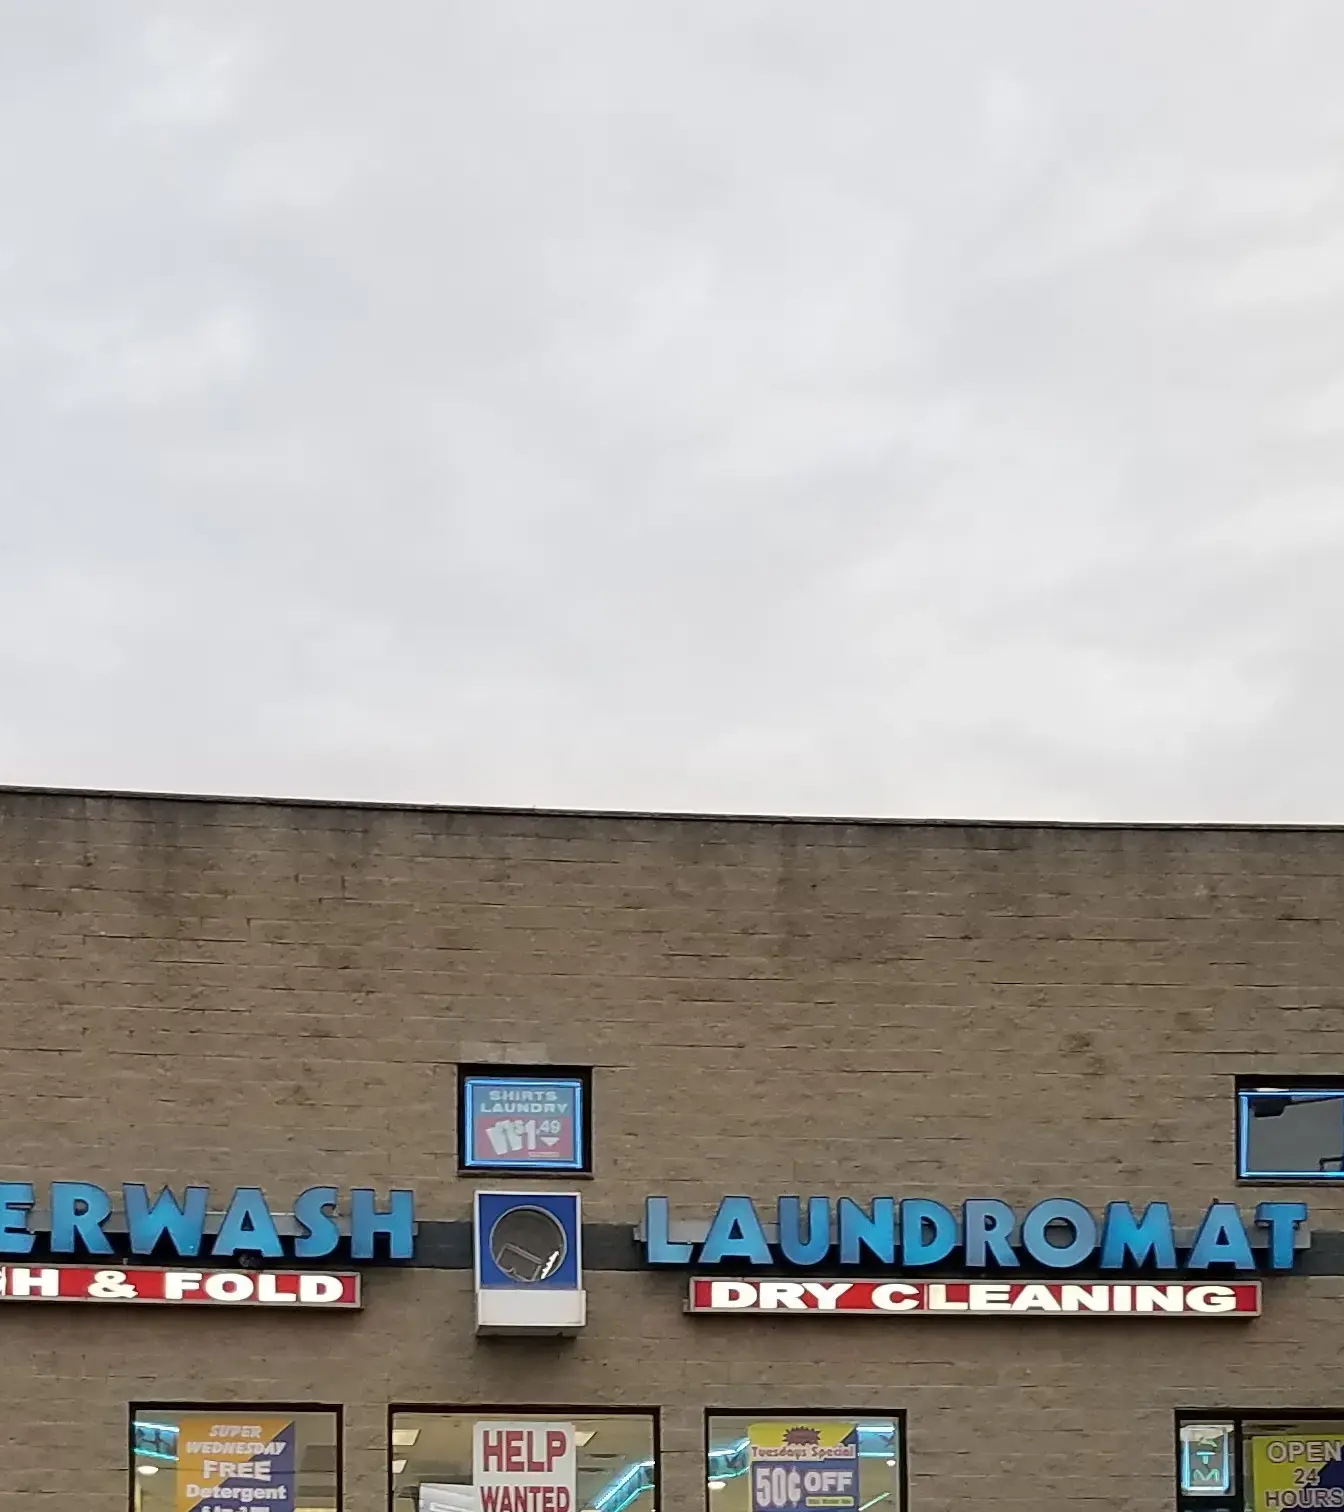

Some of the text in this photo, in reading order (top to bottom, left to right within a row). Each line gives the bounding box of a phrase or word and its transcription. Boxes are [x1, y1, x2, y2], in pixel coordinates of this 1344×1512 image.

[488, 1090, 558, 1101] SHIRTS
[480, 1103, 568, 1113] LAUNDRY
[643, 1195, 1308, 1271] LAUNDROMAT
[87, 1270, 139, 1299] &
[164, 1272, 346, 1304] FOLD
[709, 1280, 1239, 1313] DRY CLEANING
[209, 1424, 263, 1438] SUPER
[185, 1441, 287, 1456] WEDNESDAY
[482, 1430, 567, 1473] HELP
[1267, 1441, 1343, 1462] OPEN
[203, 1459, 273, 1482] FREE
[1294, 1468, 1320, 1486] 24
[804, 1471, 854, 1492] OFF
[186, 1484, 288, 1503] Detergent
